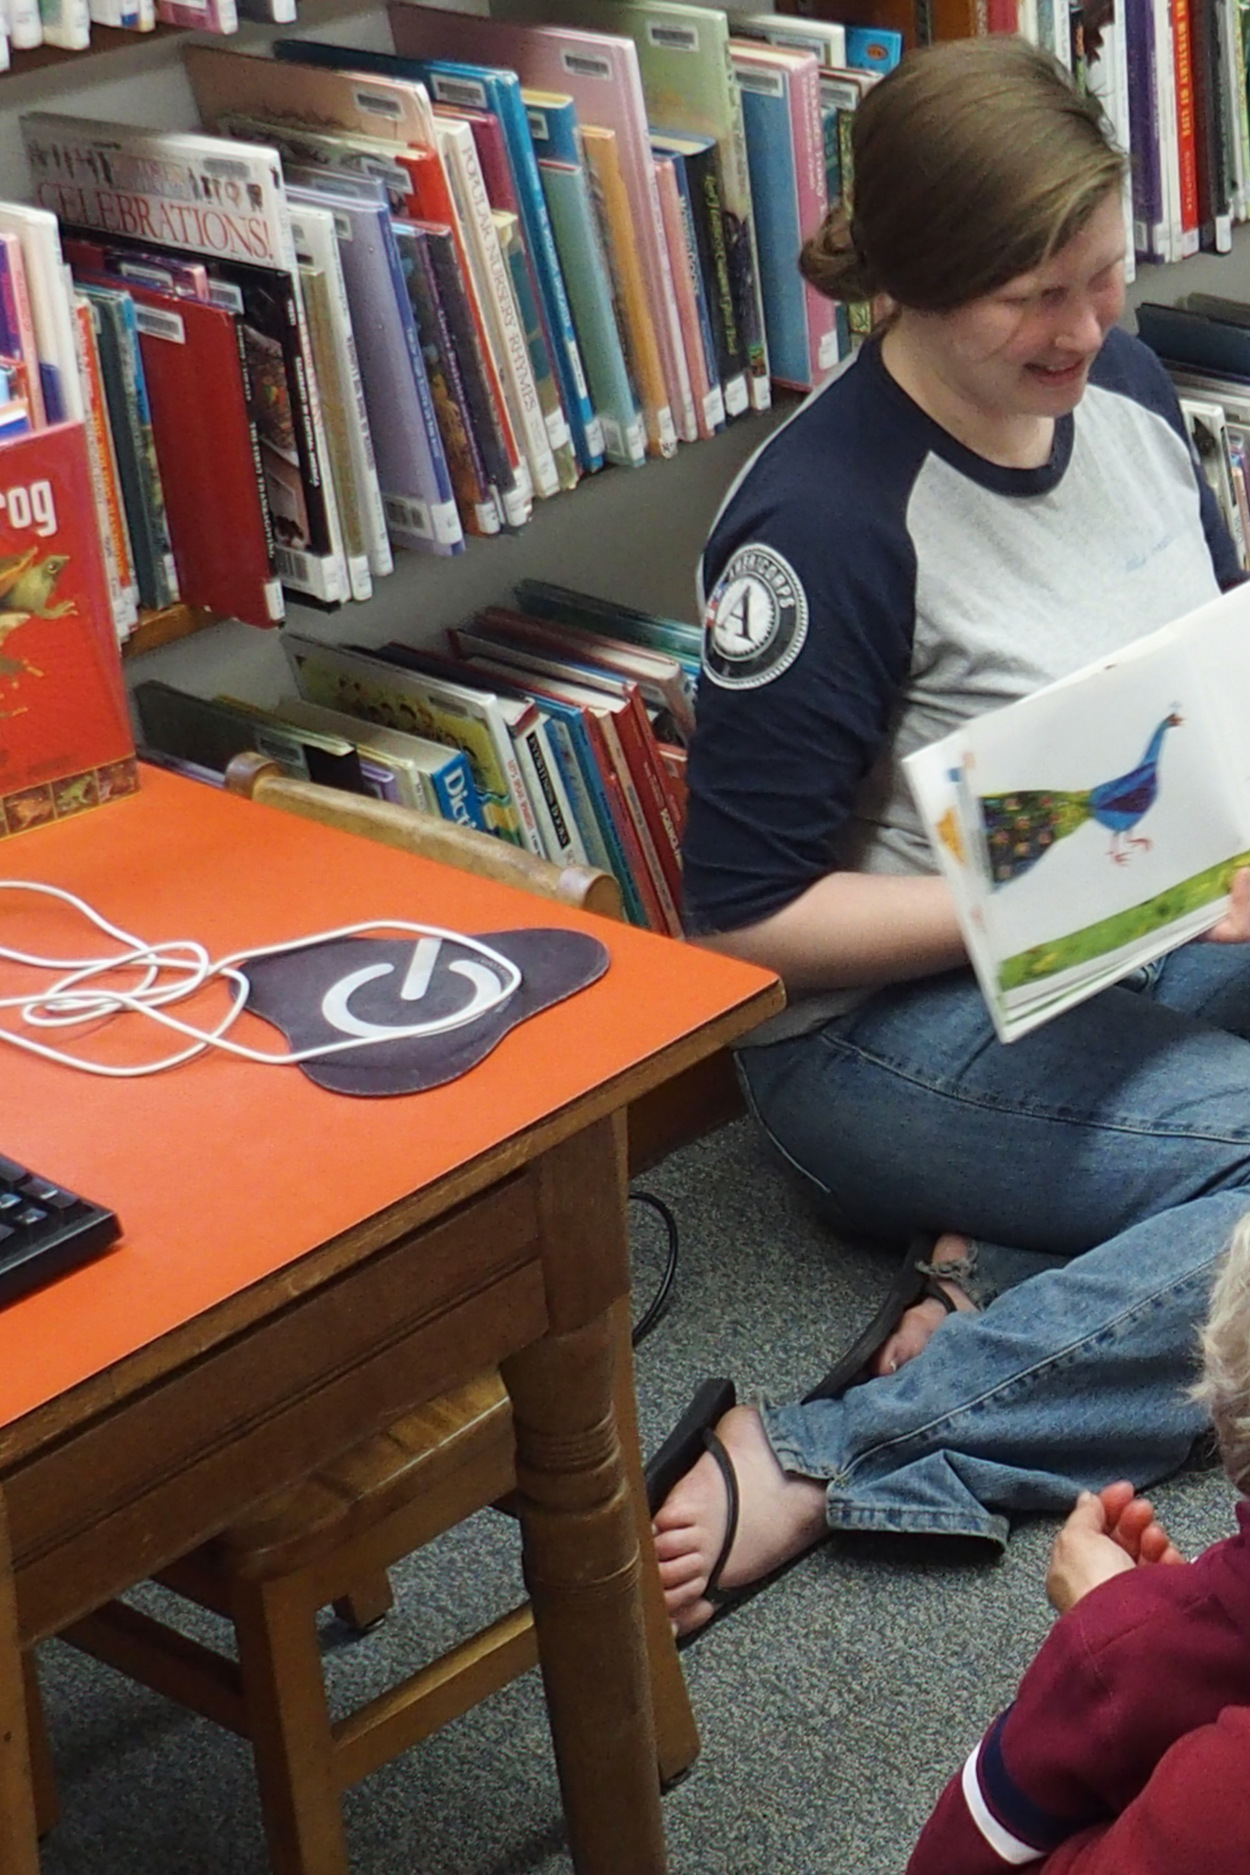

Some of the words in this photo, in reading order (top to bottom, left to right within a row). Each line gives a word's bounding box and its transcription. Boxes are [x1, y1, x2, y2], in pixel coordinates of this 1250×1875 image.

[37, 182, 274, 260] CELEBRATIONS!
[462, 146, 493, 237] POPULAR
[487, 245, 516, 329] NURSERY
[509, 334, 537, 412] RHYMES
[728, 552, 796, 610] AMERICORPS
[716, 585, 758, 644] A
[550, 805, 570, 845] BOOKS
